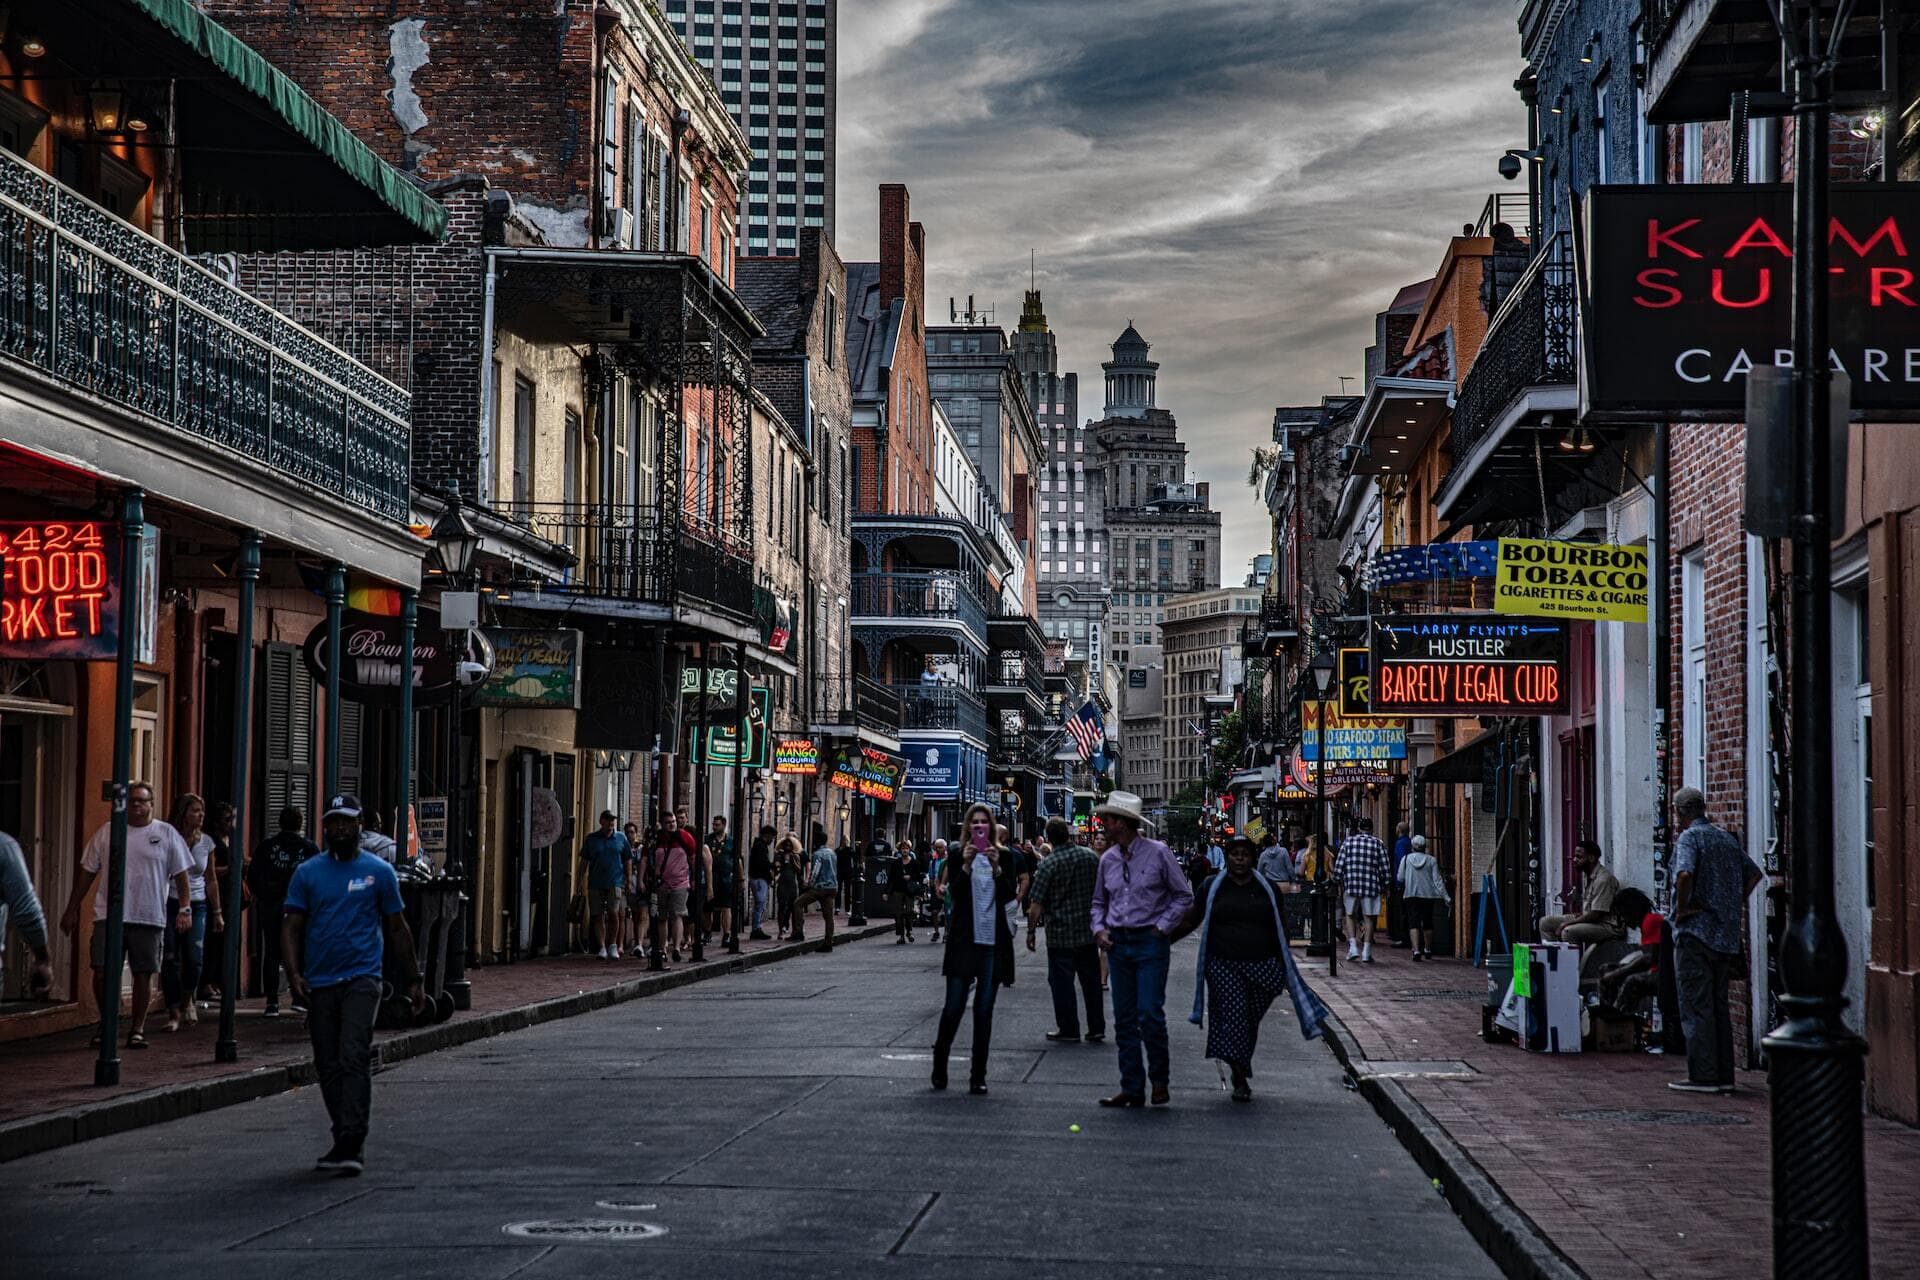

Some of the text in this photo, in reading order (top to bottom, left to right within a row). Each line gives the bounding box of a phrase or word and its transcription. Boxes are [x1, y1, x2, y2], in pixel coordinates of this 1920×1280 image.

[1503, 543, 1647, 569] BOURBON
[1505, 565, 1647, 590] TOBACCO
[1500, 584, 1647, 606] CIGARETTES & CIGARS
[1558, 604, 1594, 613] Bourbon
[1597, 606, 1609, 614] St.
[1412, 624, 1528, 636] LARRY FLYNT'S
[347, 629, 437, 659] Bouron
[1428, 639, 1505, 657] HUSTLER
[1381, 664, 1559, 704] BARELY LEGAL CLUB
[1335, 730, 1375, 744] SEAFOOD
[1378, 729, 1405, 744] STEAKS
[783, 741, 811, 749] MANGO
[776, 747, 817, 758] MANGO
[864, 748, 887, 762] NGO
[1324, 746, 1351, 759] YSTERS
[776, 756, 817, 764] DAIQUIRIS
[1308, 760, 1337, 770] CHKEN
[1361, 760, 1388, 769] SHACK
[839, 763, 892, 785] DAUIRIS
[1335, 767, 1374, 775] AUTHENTIC
[1332, 775, 1367, 784] ORLEANS
[1367, 775, 1395, 784] CUISINE
